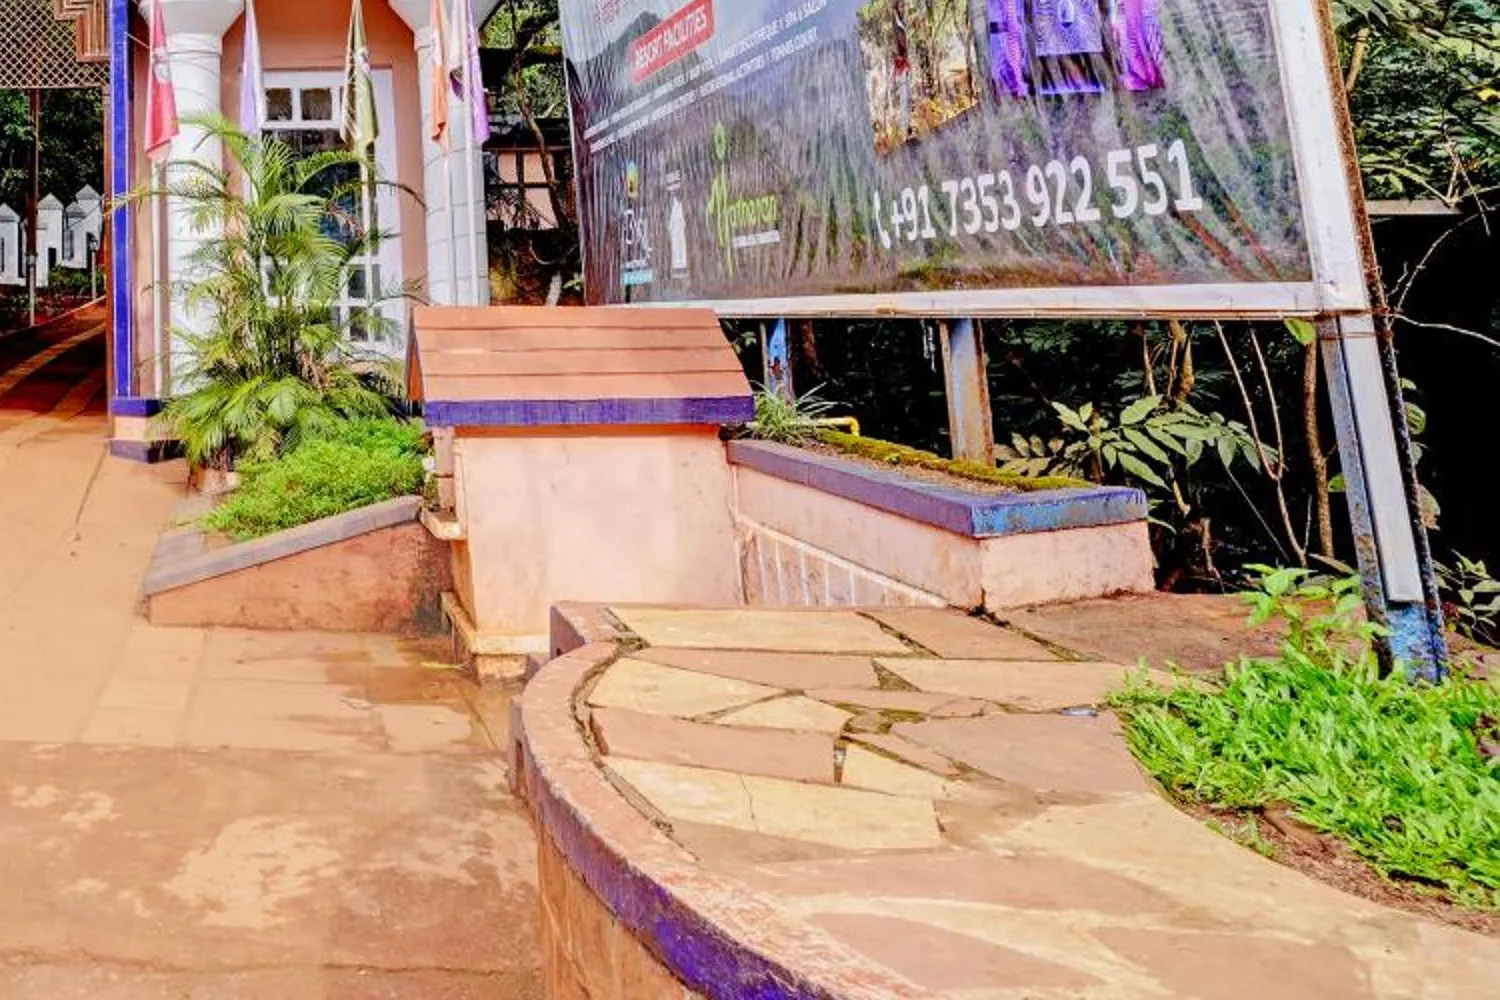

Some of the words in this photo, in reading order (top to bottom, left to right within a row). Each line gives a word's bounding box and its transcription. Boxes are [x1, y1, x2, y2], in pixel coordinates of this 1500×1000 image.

[891, 185, 936, 241] +91
[942, 170, 1023, 236] 7353
[1025, 155, 1101, 227] 922
[1106, 138, 1203, 220] 551
